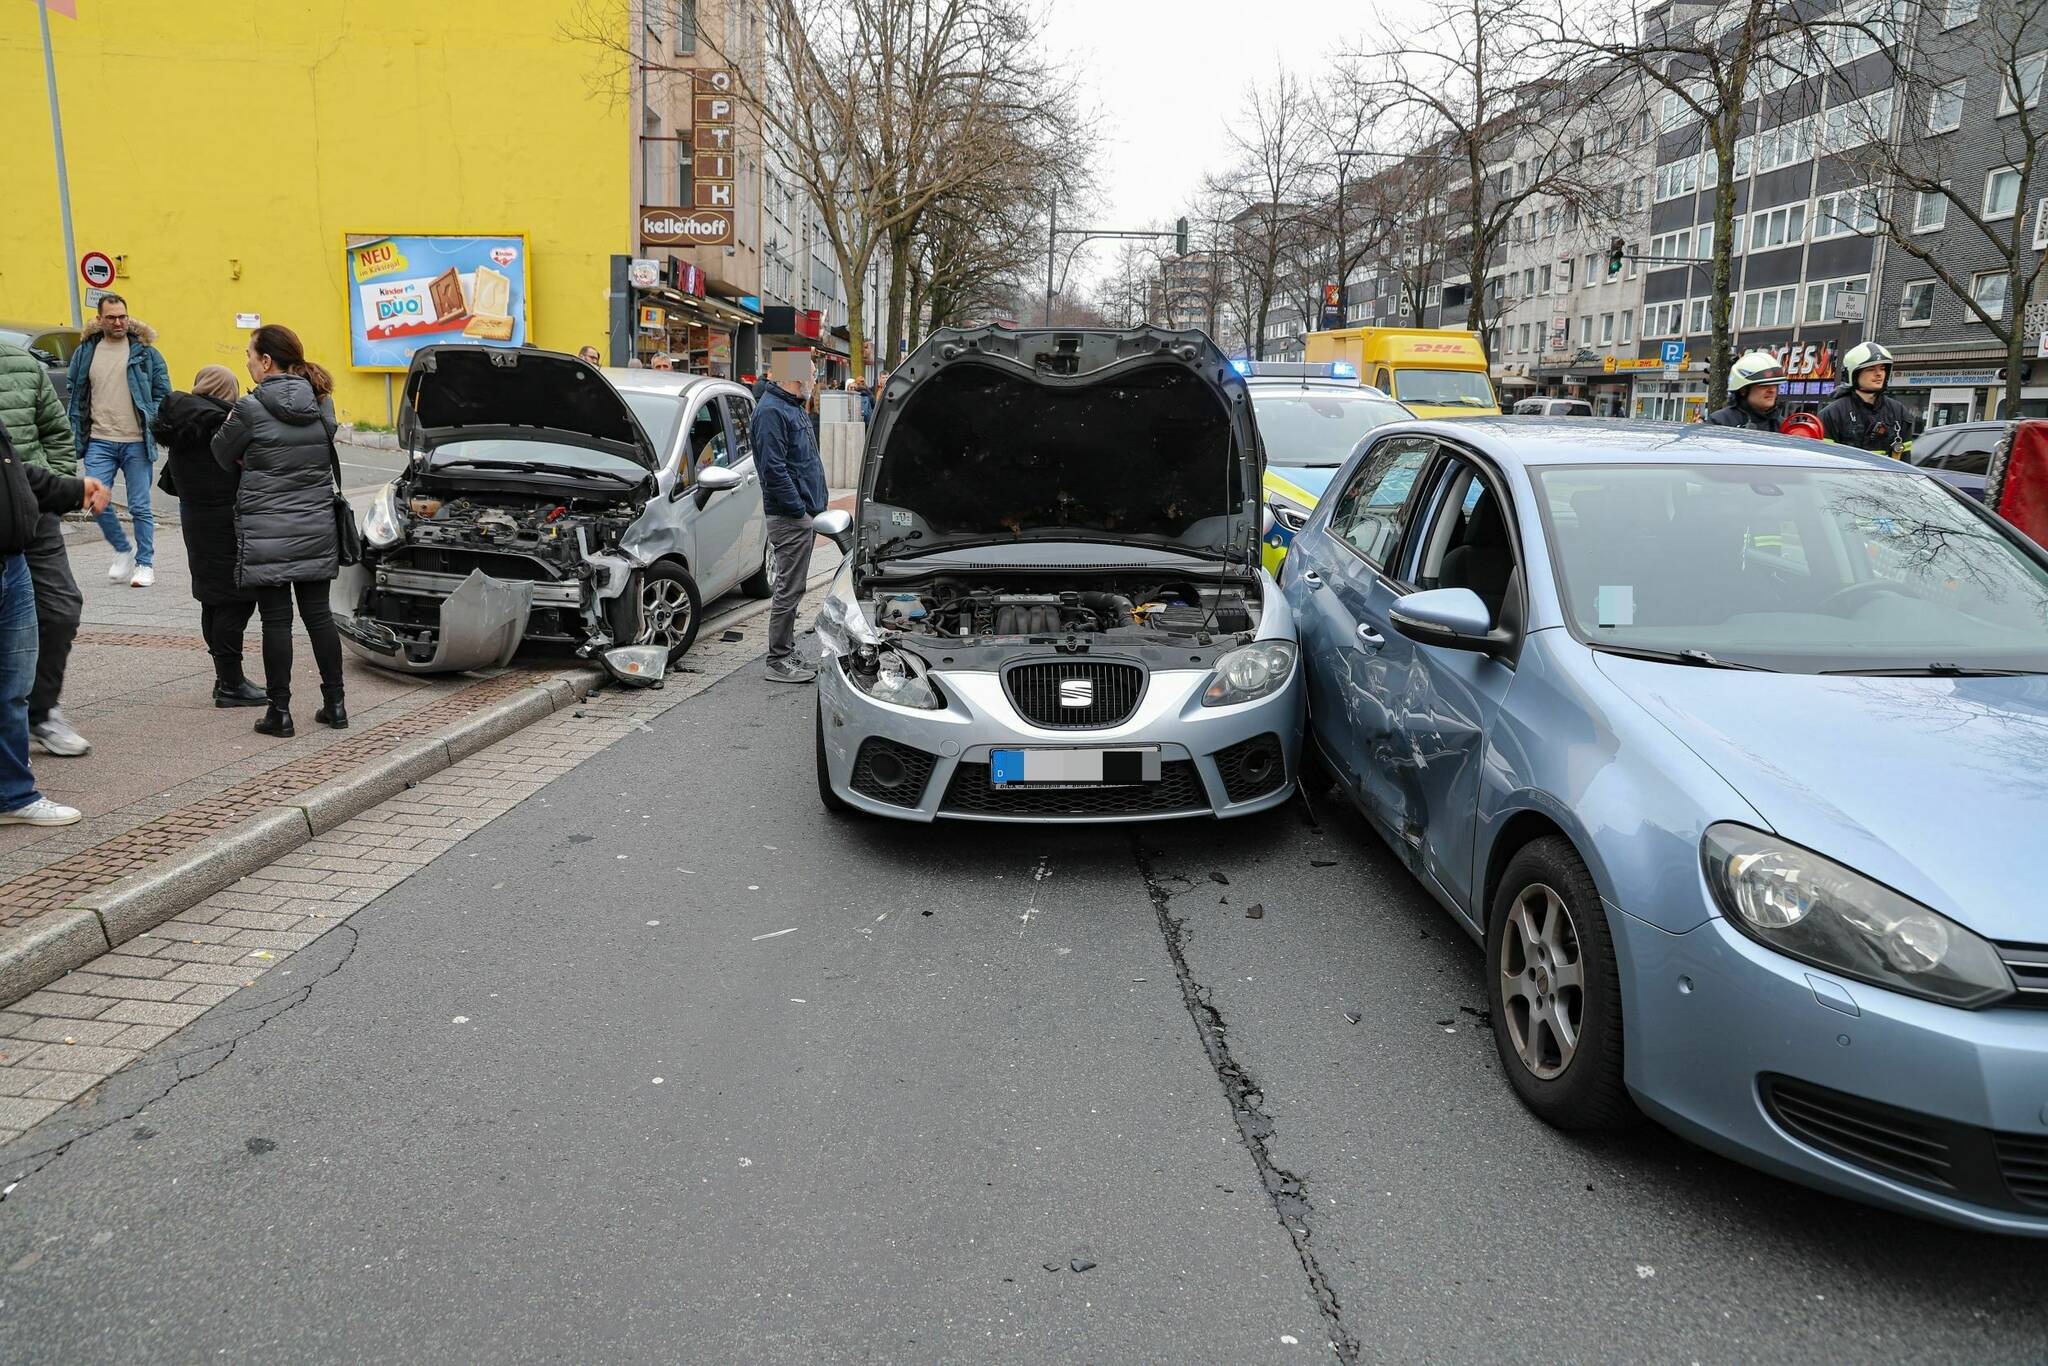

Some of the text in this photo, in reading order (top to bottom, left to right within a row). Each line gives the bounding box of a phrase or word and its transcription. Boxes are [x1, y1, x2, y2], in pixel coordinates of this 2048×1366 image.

[711, 72, 730, 204] OPTIK
[643, 217, 726, 235] kellerhoff
[361, 246, 391, 266] NEU
[1413, 343, 1466, 354] DHL
[1666, 344, 1679, 361] P
[1639, 360, 1652, 368] DHL
[997, 769, 1003, 777] D
